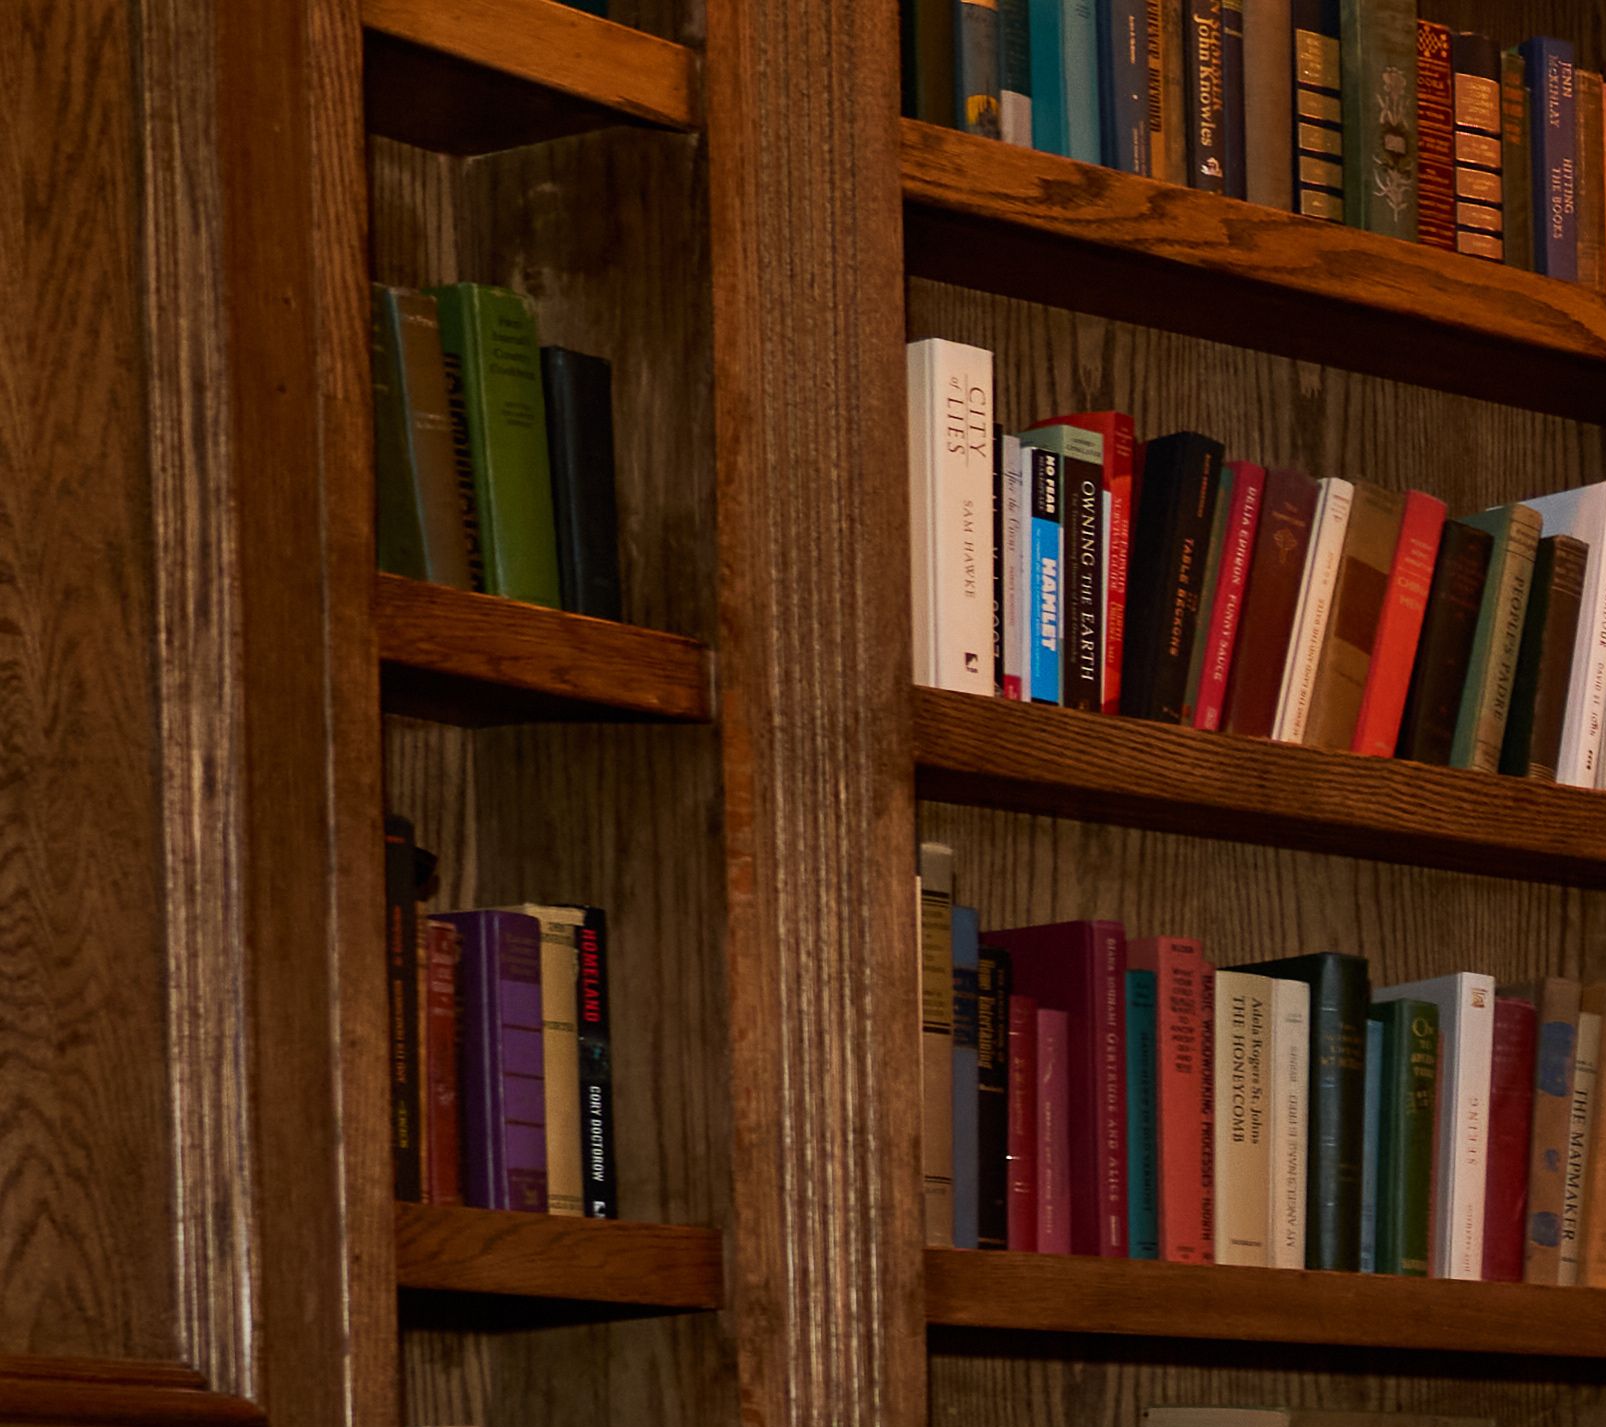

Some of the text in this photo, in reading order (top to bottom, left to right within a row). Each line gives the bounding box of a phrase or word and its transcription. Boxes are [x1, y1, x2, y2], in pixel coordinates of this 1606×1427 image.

[1196, 15, 1211, 147] John Knowles
[1561, 59, 1572, 99] JENN
[1552, 167, 1562, 241] THE BOOKS
[1563, 157, 1573, 214] HITTING
[947, 377, 965, 455] of LIES
[968, 385, 986, 459] CITY
[964, 500, 975, 599] SAM HAWKE
[1081, 480, 1096, 681] OWNING THE EARTH
[1214, 486, 1258, 680] DELIA EPHRON FUNNY SAUCE
[1041, 558, 1057, 651] HAMLET
[582, 929, 601, 1022] HOMELAND
[1231, 996, 1247, 1143] THE HONEYCOMB
[589, 1086, 604, 1182] CORY DOCTOROW
[1562, 1089, 1589, 1241] THE MAPMAKER
